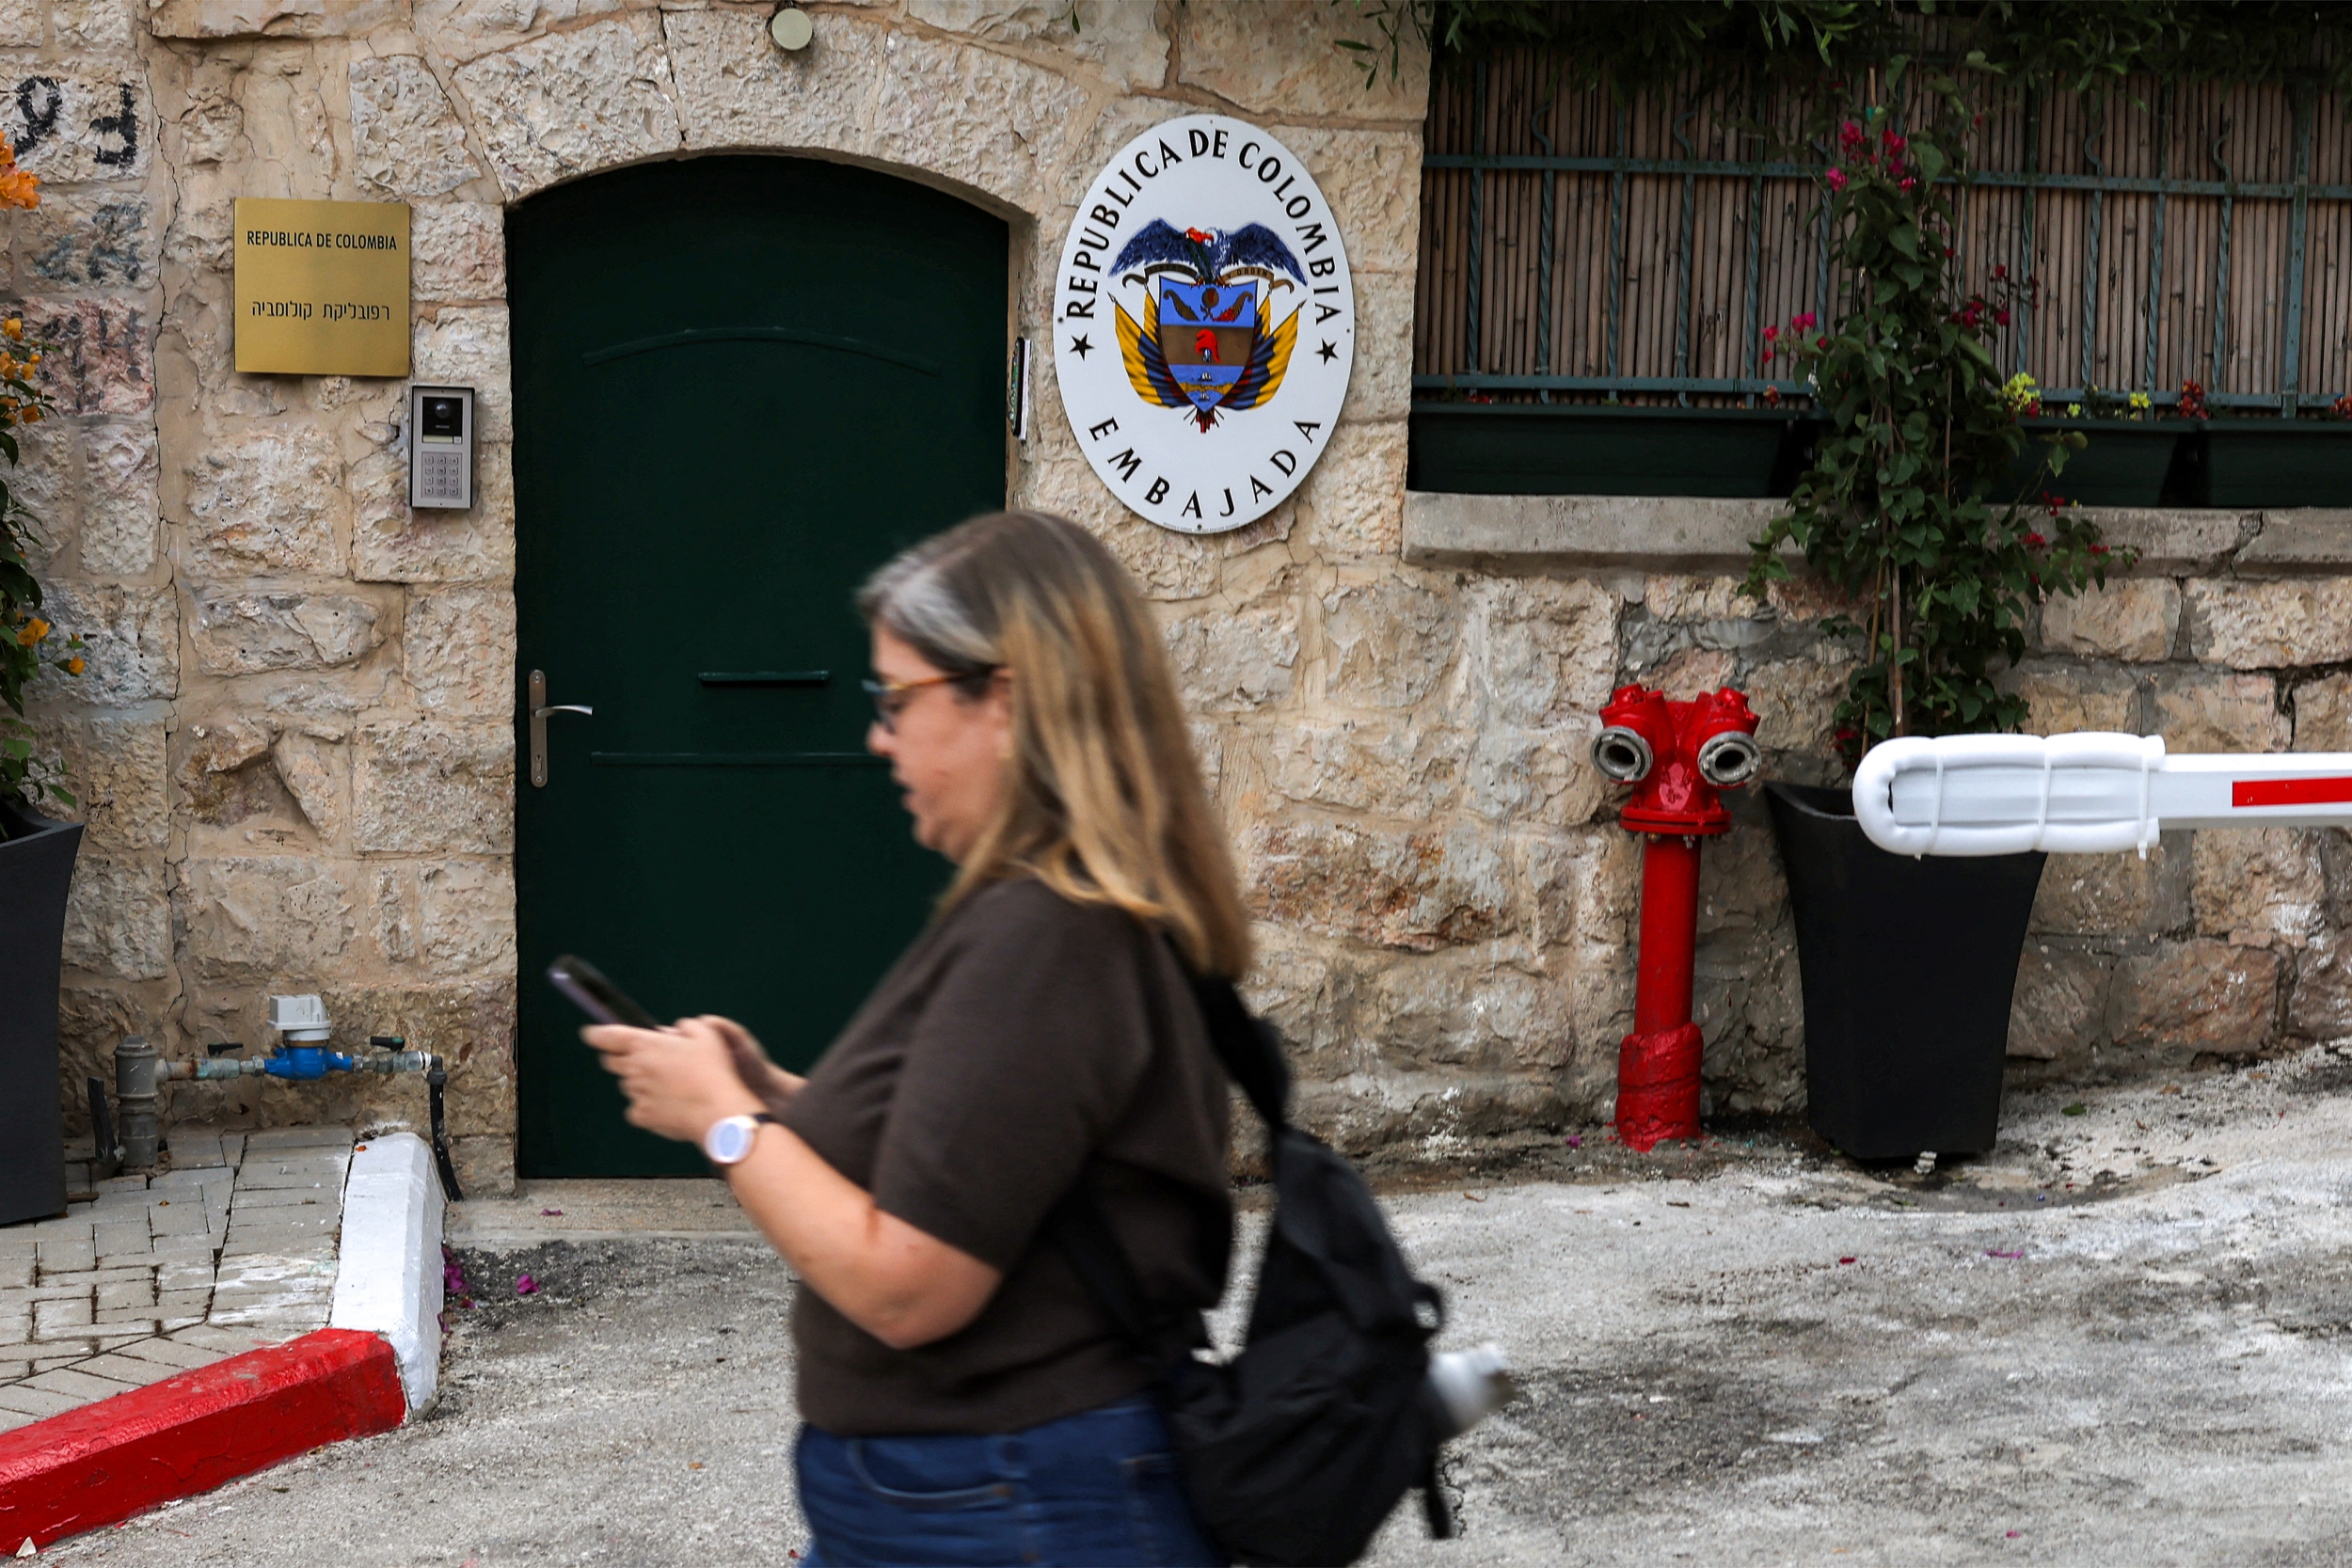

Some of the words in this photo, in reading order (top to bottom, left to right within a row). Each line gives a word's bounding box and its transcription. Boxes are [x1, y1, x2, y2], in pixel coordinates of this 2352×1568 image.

[1066, 137, 1184, 320] REPUBLICA
[1187, 128, 1230, 159] DE
[1238, 141, 1343, 325] COLOMBIA
[246, 230, 313, 247] REPUBLICA
[316, 233, 332, 248] DE
[335, 234, 397, 250] COLOMBIA
[252, 300, 312, 321] קולומביה
[323, 302, 390, 322] רפובליקת
[1089, 416, 1322, 519] EMBAJADA
